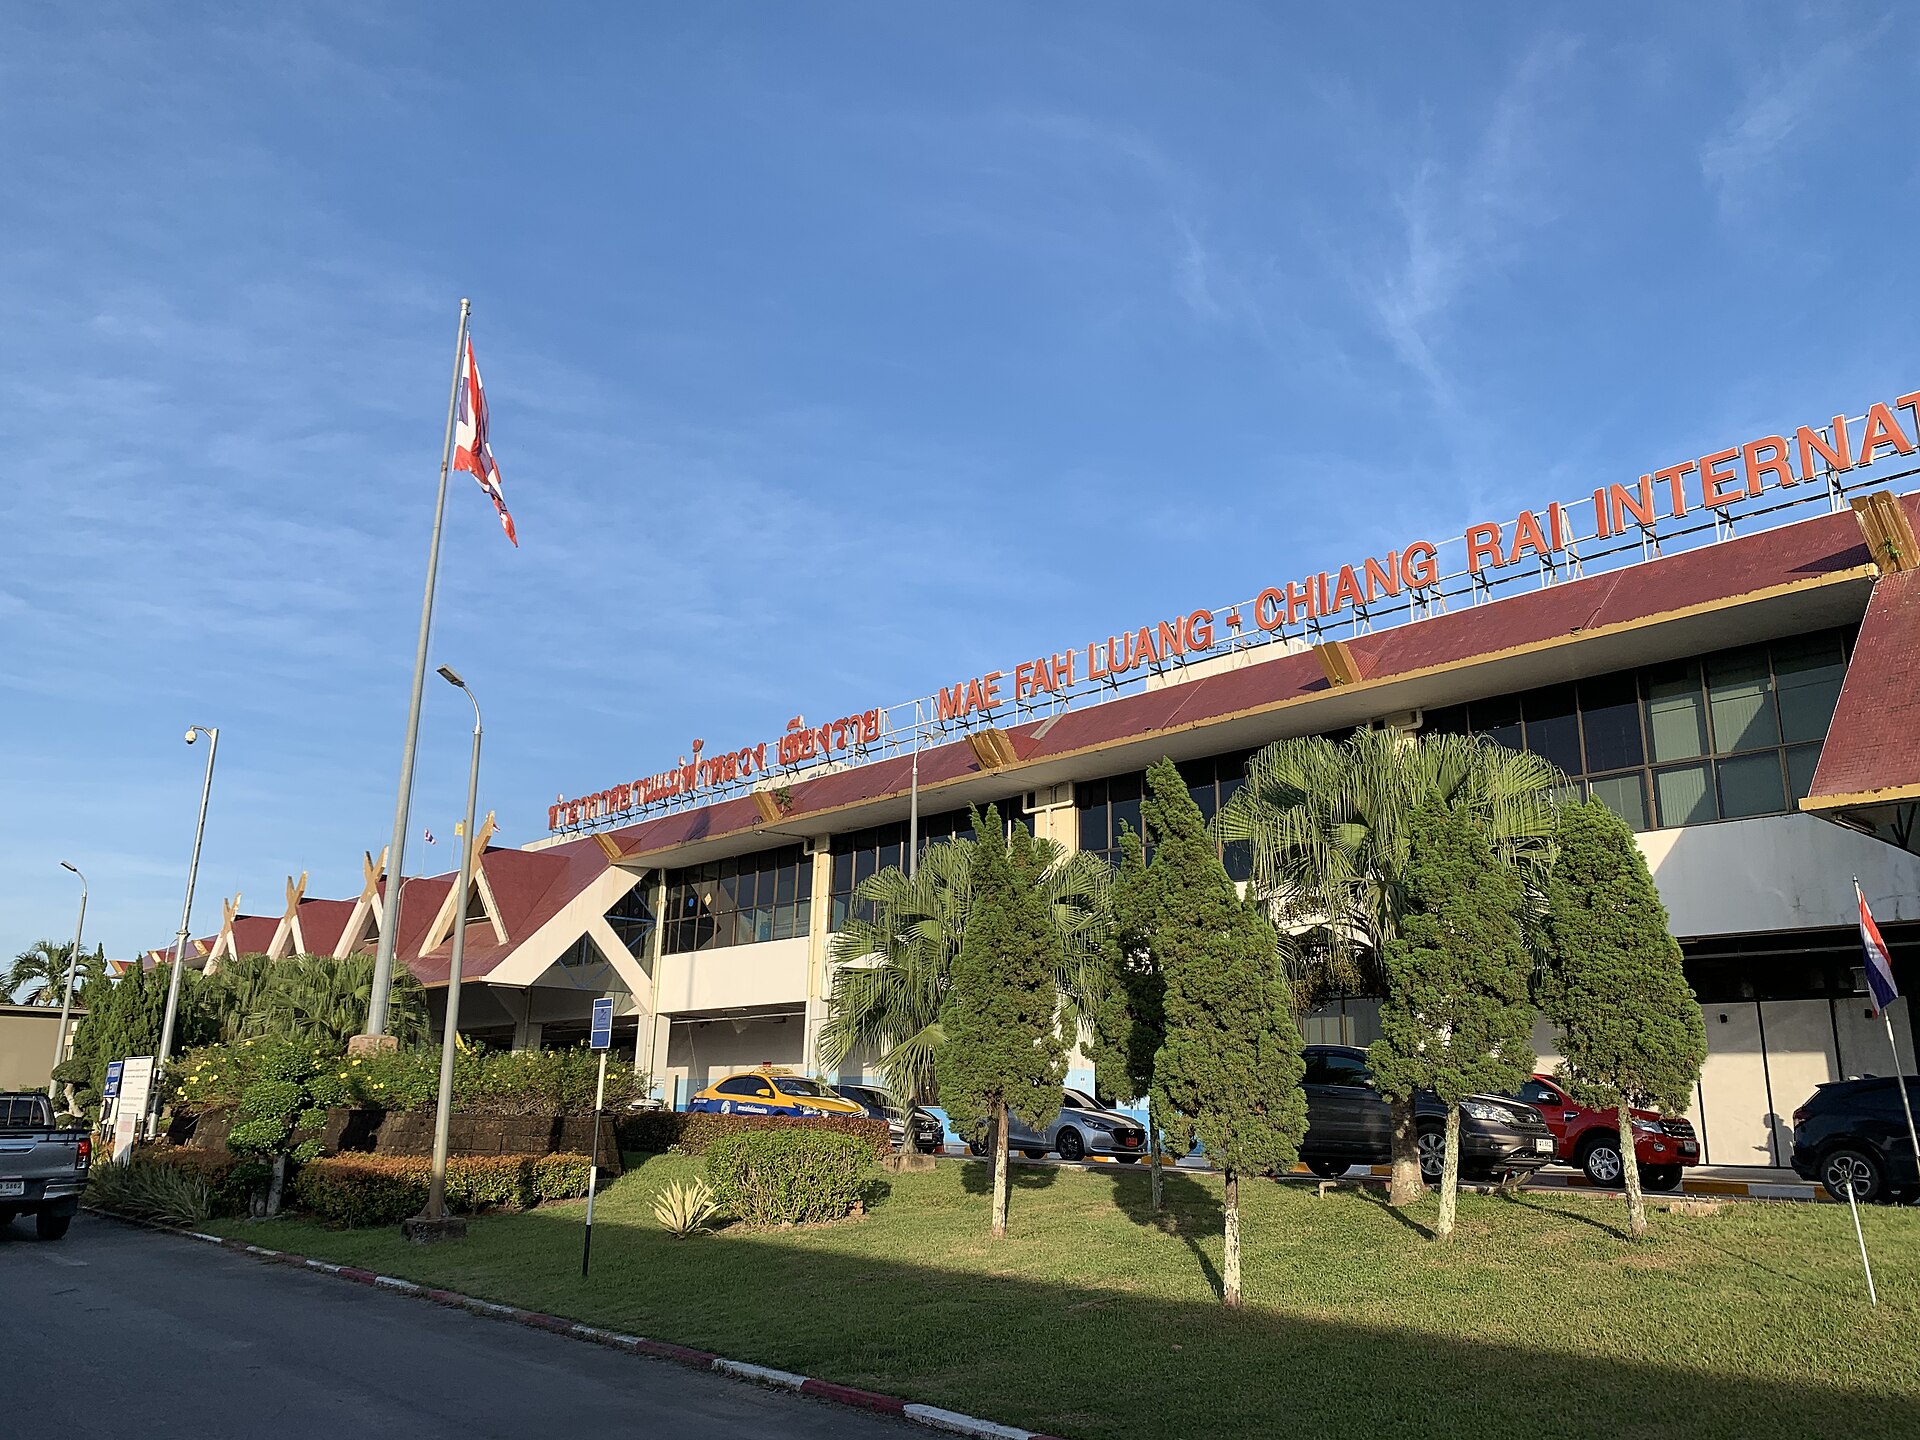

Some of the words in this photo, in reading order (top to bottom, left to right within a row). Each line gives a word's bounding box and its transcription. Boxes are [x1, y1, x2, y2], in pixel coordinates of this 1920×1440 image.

[938, 670, 1002, 721] MAE
[1015, 647, 1075, 700] FAH
[1088, 608, 1215, 681] LUANG
[1254, 540, 1438, 631] CHIANG
[1466, 501, 1564, 575] RAI
[778, 706, 882, 766] เชียงราย
